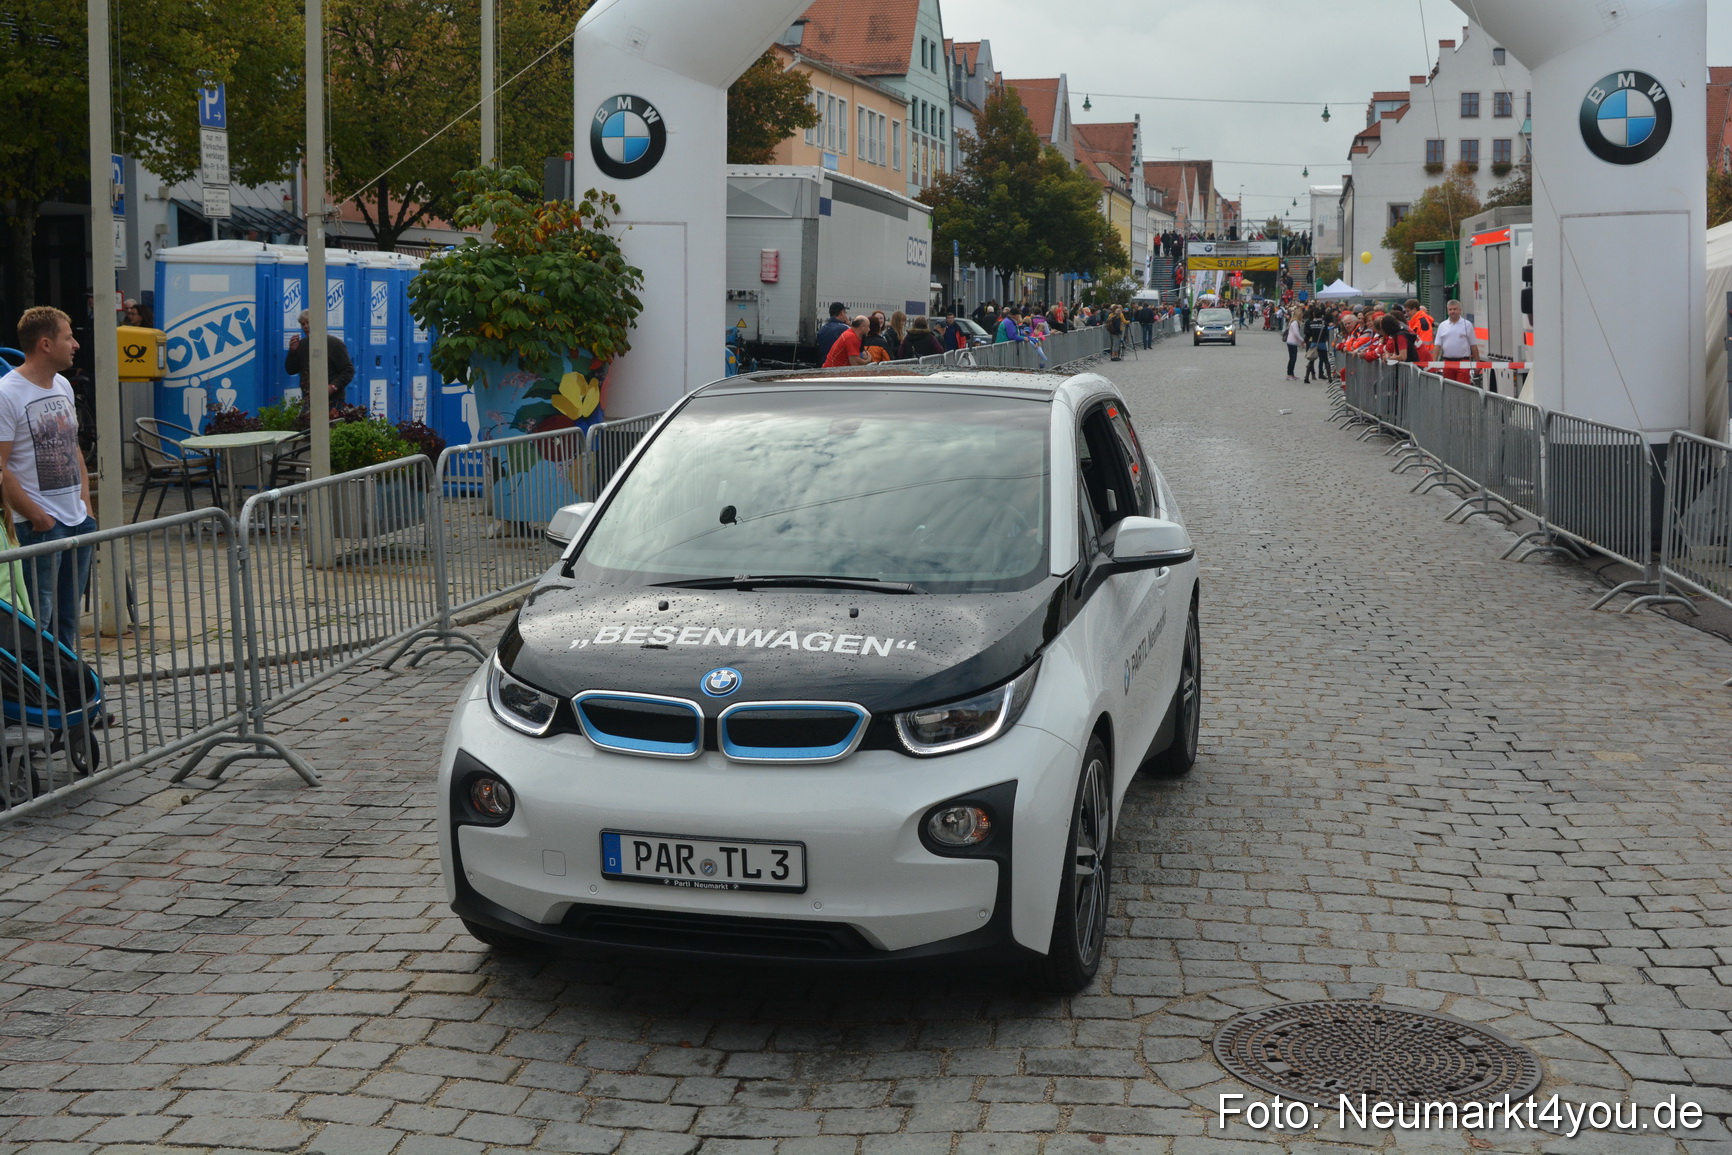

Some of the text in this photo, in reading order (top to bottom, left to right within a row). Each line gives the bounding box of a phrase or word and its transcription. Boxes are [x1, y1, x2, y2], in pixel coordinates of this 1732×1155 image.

[1587, 72, 1666, 105] BMW
[595, 96, 660, 124] BMW
[144, 240, 152, 259] 3
[1217, 260, 1248, 268] START
[43, 400, 66, 413] JUST
[609, 857, 616, 866] D
[633, 840, 789, 880] PAR TL 3
[694, 881, 729, 890] Neumarkt
